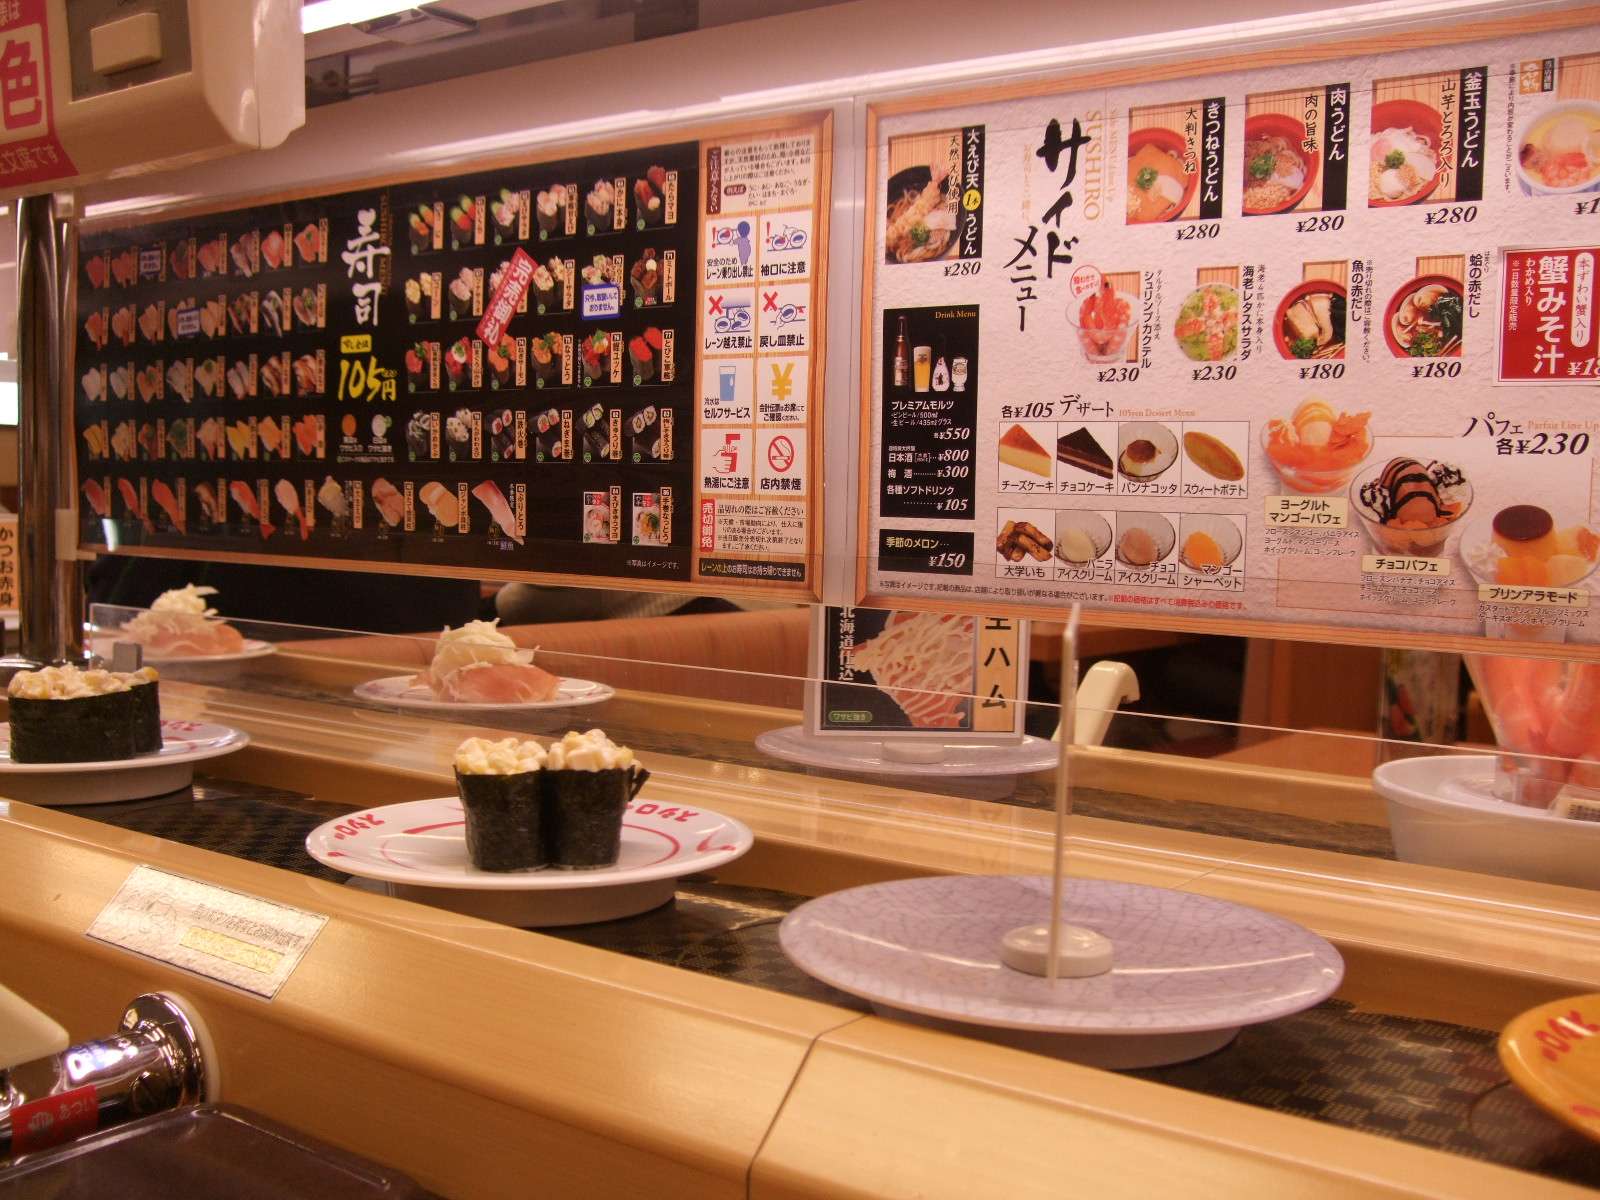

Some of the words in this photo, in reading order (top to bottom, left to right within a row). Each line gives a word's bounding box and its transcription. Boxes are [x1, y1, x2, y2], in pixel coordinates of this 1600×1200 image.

[0, 39, 42, 131] 色
[1303, 95, 1319, 152] 肉の旨味
[1328, 88, 1347, 161] 肉うどん
[1460, 72, 1483, 168] 釜玉うどん
[1183, 107, 1198, 173] 大判きつね
[1438, 79, 1456, 189] 山芋とろろ入り
[1203, 102, 1222, 202] きつねうどん
[1083, 110, 1101, 221] SUSHIRO
[947, 135, 962, 217] 天然えび使用
[1036, 117, 1092, 279] サイド
[1424, 205, 1477, 225] ¥280
[1295, 214, 1344, 233] ¥280
[1175, 223, 1220, 241] ¥280
[341, 208, 391, 327] 寿司
[706, 266, 753, 280] レーン乗り出し禁止
[760, 261, 806, 277] 袖口に注意
[943, 261, 981, 277] ¥280
[1003, 224, 1039, 332] メニュー
[1467, 253, 1483, 319] 蛤の赤だし
[1524, 257, 1536, 306] わかめ入り
[1350, 259, 1364, 322] 魚の赤だし
[1574, 255, 1592, 344] 本ずわい蟹入り
[1141, 271, 1155, 369] シュリンプカクテル
[1240, 265, 1255, 361] 海老レタスサラダ
[1532, 255, 1569, 376] 蟹みそ汁
[705, 336, 752, 349] レーン越え禁止
[759, 334, 805, 348] 戻し皿禁止
[1096, 367, 1139, 383] ¥230
[1191, 366, 1237, 381] ¥230
[1299, 362, 1345, 379] ¥180
[1410, 361, 1462, 378] ¥180
[703, 407, 751, 419] セルフサービス
[891, 400, 954, 411] プレミアムモルツ
[1059, 394, 1115, 418] デザート
[1462, 411, 1524, 437] パフェ
[1496, 432, 1590, 456] 各¥230
[888, 452, 913, 463] 日本酒
[937, 449, 969, 462] ¥800
[936, 465, 969, 478] ¥300
[704, 477, 750, 490] 熱湯にご注意
[760, 478, 802, 491] 店内禁煙
[886, 485, 954, 496] 各種ソフトドリンク
[1001, 480, 1054, 491] チーズケーキ
[1060, 481, 1115, 493] チョコケーキ
[1121, 482, 1178, 495] パンナコッタ
[1183, 484, 1246, 496] スウィートポテト
[936, 498, 968, 511] ¥105
[1280, 499, 1331, 512] ヨーグルト
[1269, 512, 1342, 525] マンゴーパフェ
[928, 552, 965, 568] ¥150
[1086, 559, 1113, 570] バニラ
[1150, 562, 1176, 573] チョコ
[1375, 558, 1438, 572] チョコパフェ
[1004, 565, 1046, 578] 大学いも
[1056, 569, 1113, 582] アイスクリーム
[1201, 564, 1243, 575] マンゴー
[1117, 571, 1176, 586] アイスクリーム
[1182, 576, 1243, 589] シャーベット
[1489, 588, 1578, 603] プリンアラモード
